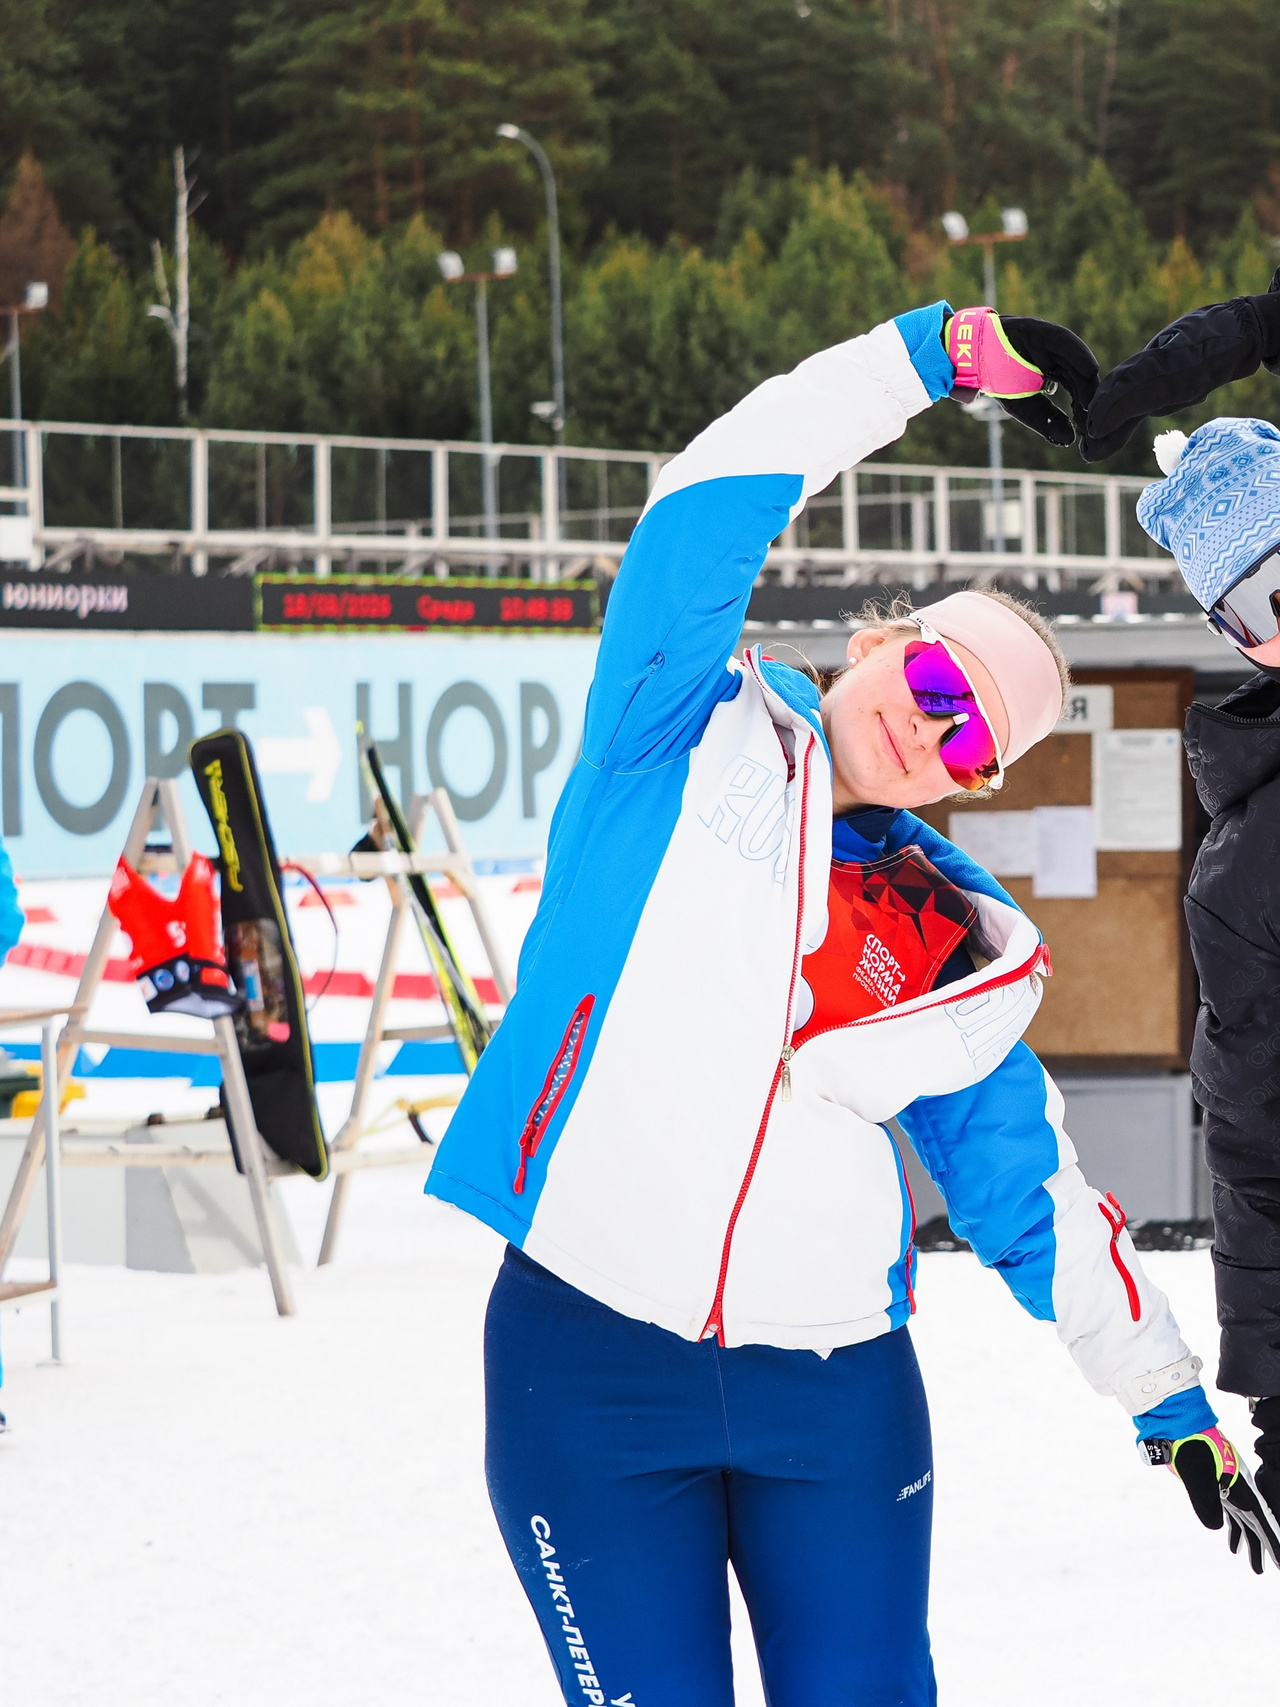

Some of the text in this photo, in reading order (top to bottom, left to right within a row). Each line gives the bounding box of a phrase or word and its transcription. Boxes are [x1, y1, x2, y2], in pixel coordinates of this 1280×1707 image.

[956, 311, 976, 368] LEKI
[3, 581, 128, 619] юниорки
[356, 681, 560, 823] НОР
[858, 953, 897, 1006] ЖИЗНИ
[863, 943, 902, 995] НОРМА
[866, 933, 901, 975] СПОРТ
[852, 972, 875, 997] ПРОЕКТ
[901, 1469, 931, 1500] FANLIFE
[530, 1514, 608, 1707] САНКТ-ПЕТЕР
